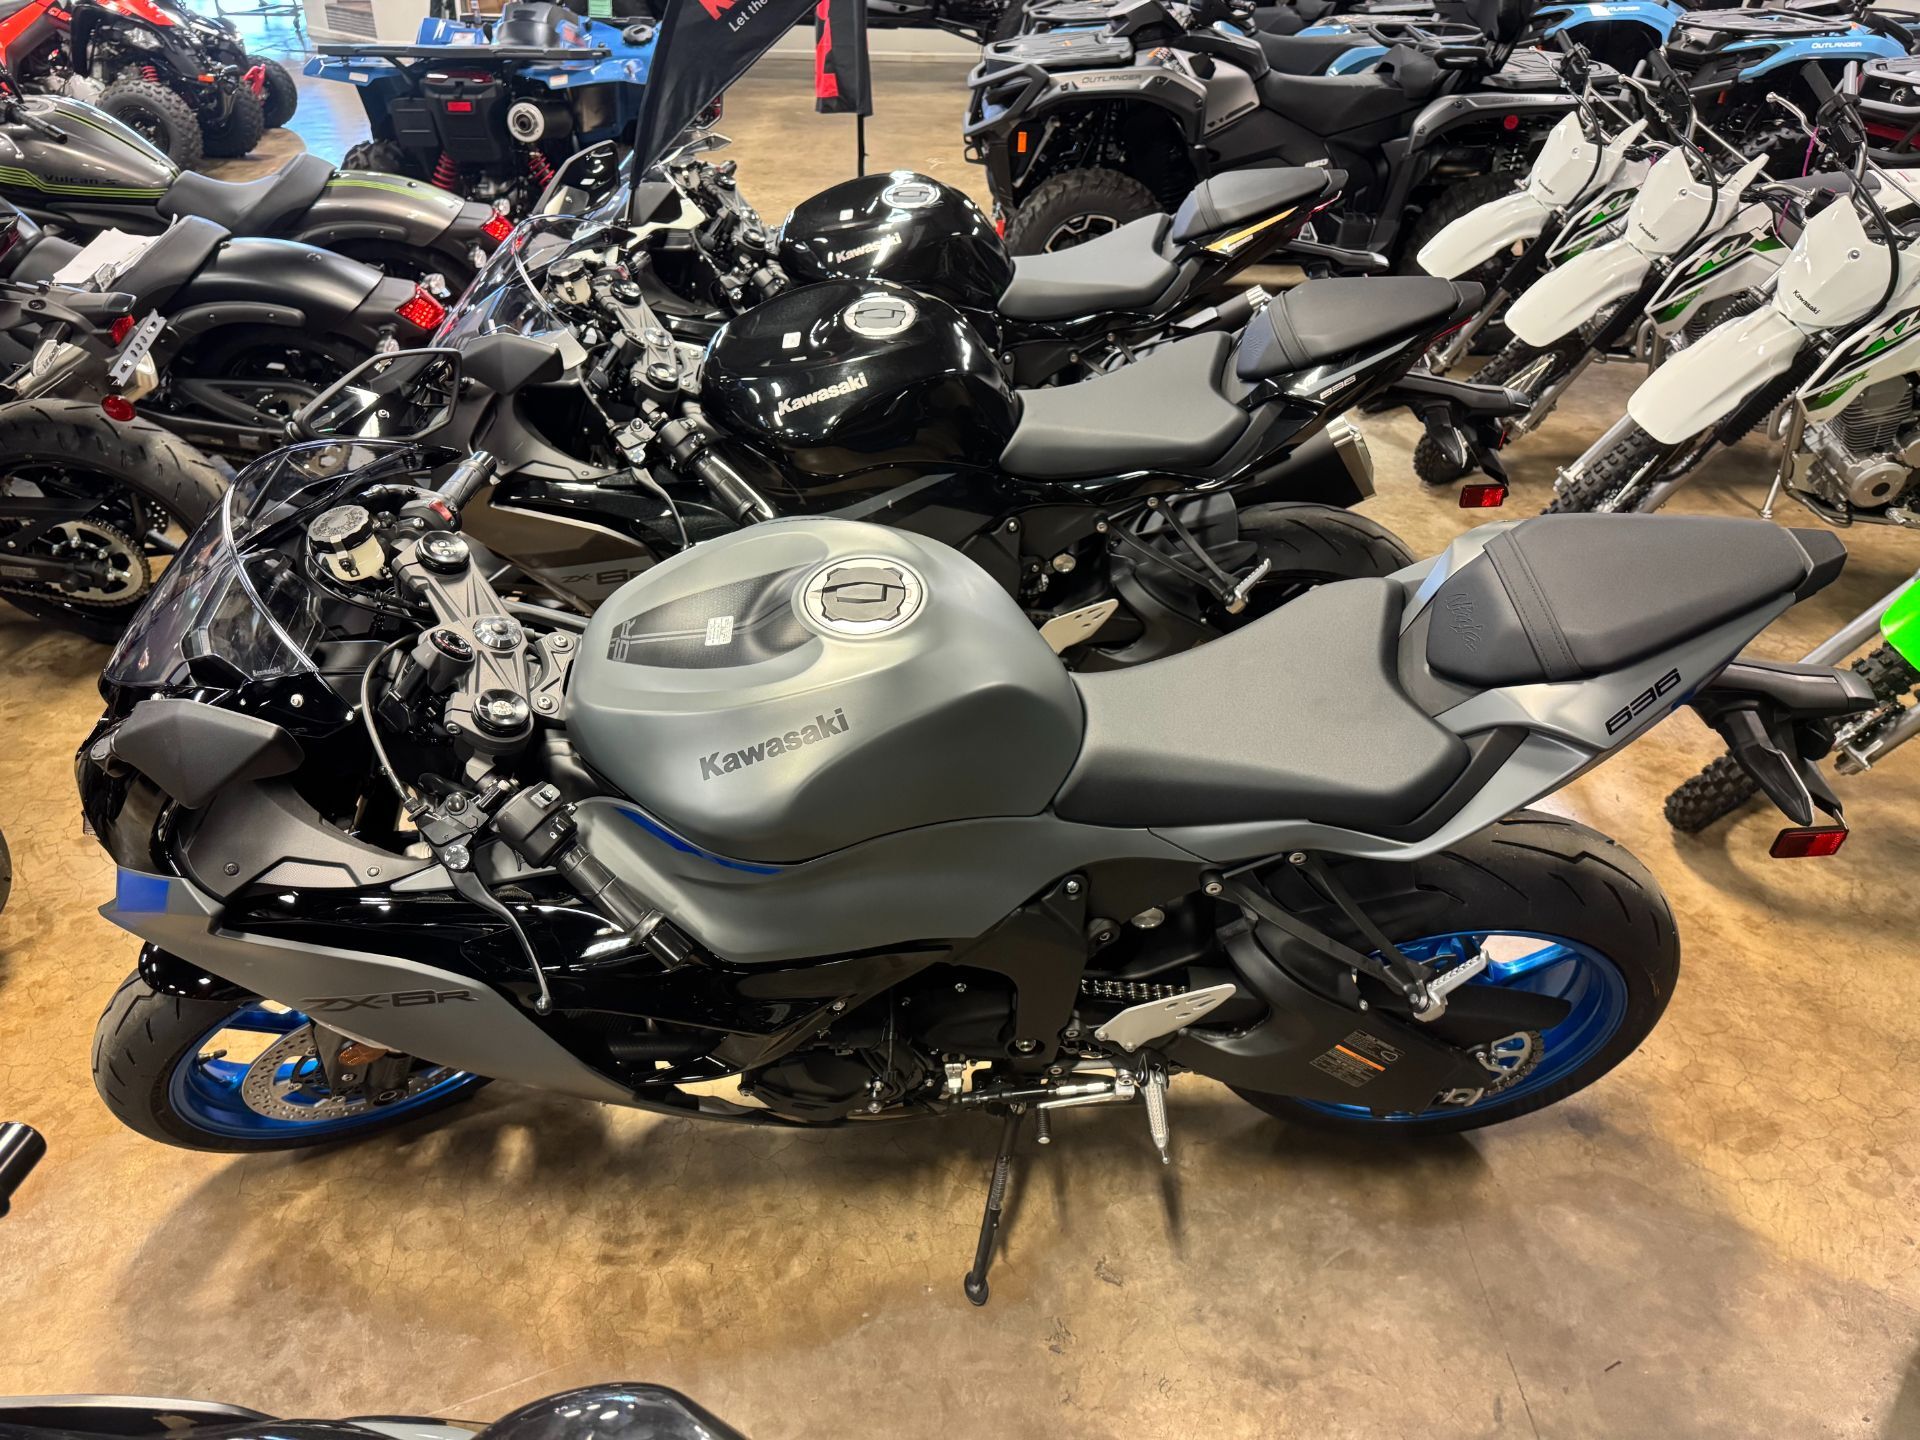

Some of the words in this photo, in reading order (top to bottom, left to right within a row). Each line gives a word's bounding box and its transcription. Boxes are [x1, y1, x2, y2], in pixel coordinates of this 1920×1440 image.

[728, 11, 750, 32] Let
[1811, 41, 1863, 49] OUTLANDER
[1082, 74, 1142, 84] OUTLANDER
[835, 232, 902, 264] Kawaski
[1792, 289, 1821, 315] Kawasaki
[777, 371, 868, 417] Kawasaki
[1319, 375, 1357, 400] 636
[1605, 667, 1681, 736] 636
[699, 707, 849, 781] Kawasaki
